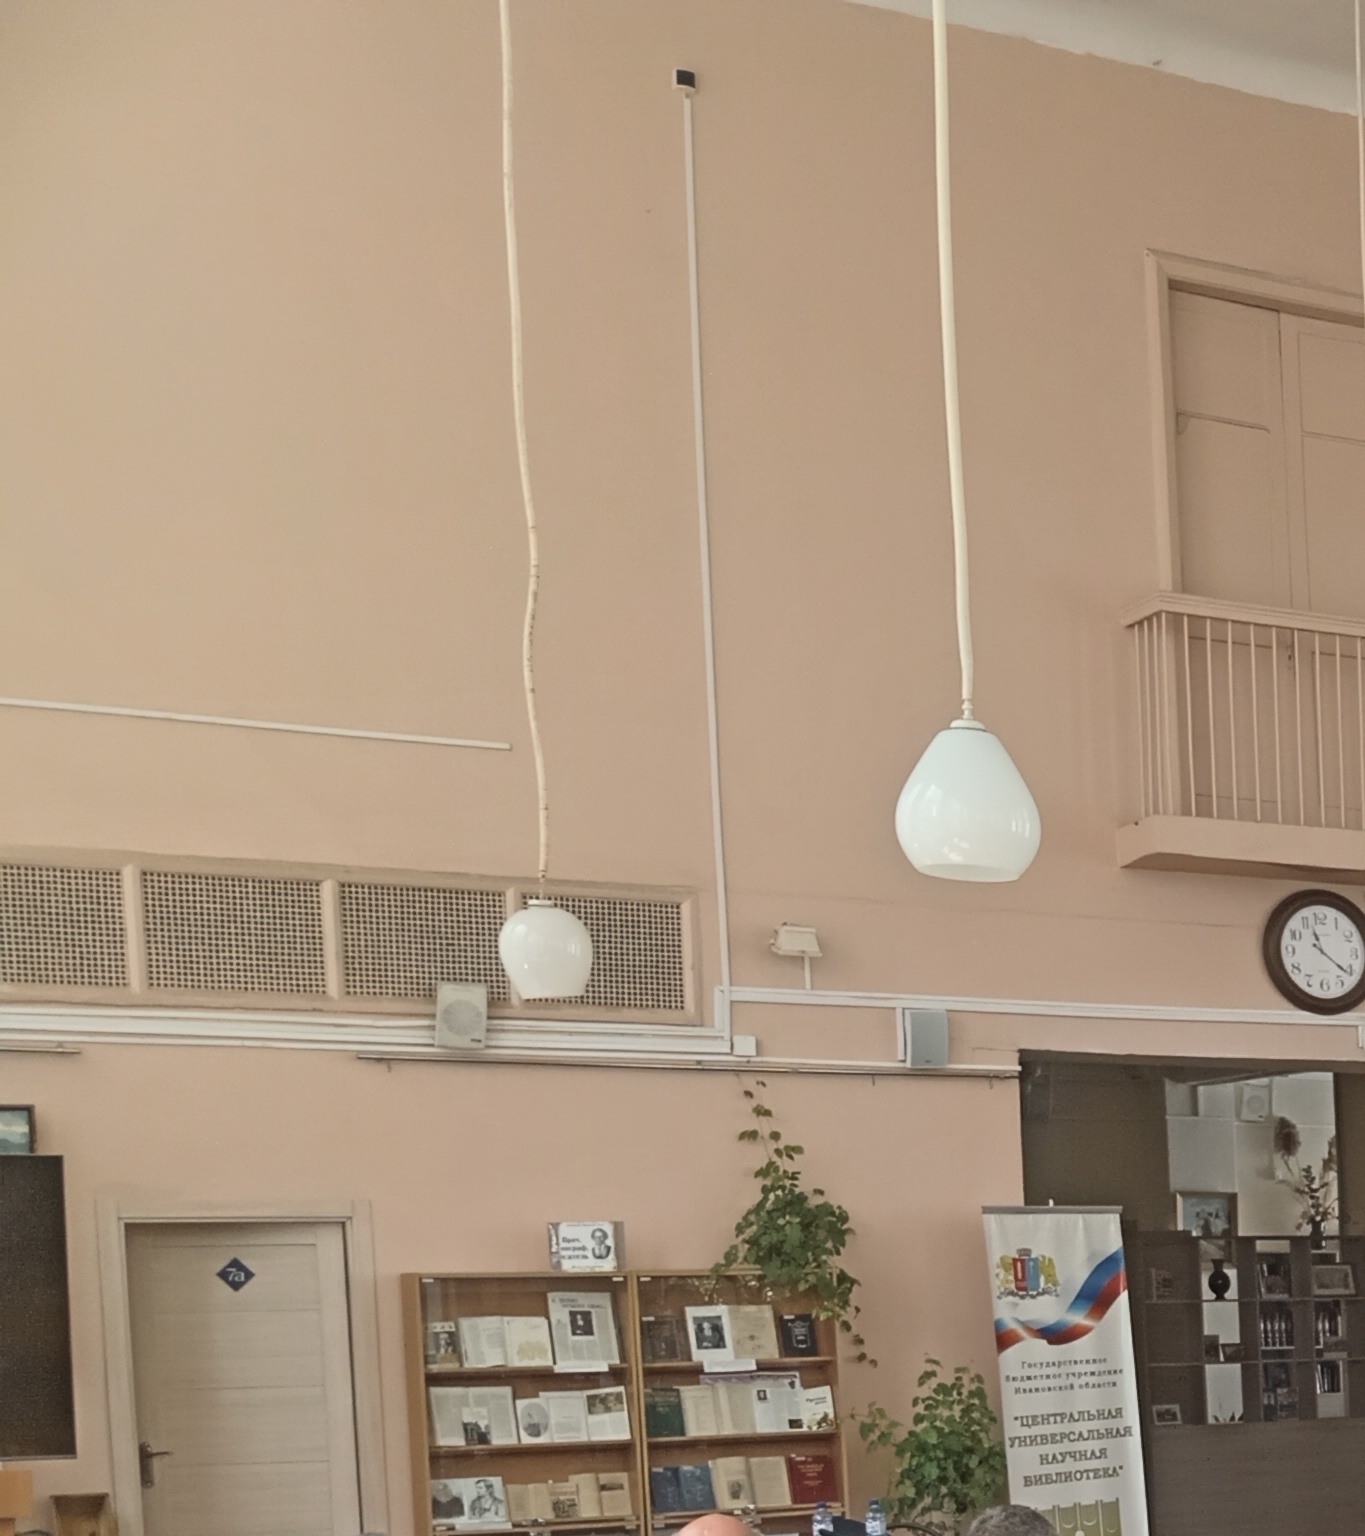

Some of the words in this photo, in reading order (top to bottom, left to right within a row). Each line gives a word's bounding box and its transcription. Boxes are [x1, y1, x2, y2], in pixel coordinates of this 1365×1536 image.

[1301, 916, 1309, 929] 11
[1313, 912, 1327, 926] 12
[1334, 917, 1338, 930] 1
[1290, 929, 1302, 941] 10
[1343, 930, 1353, 943] 2
[1285, 944, 1296, 958] 9
[1350, 947, 1359, 960] 3
[1291, 962, 1301, 975] 8
[1304, 974, 1313, 988] 7
[1320, 978, 1330, 992] 6
[1335, 975, 1345, 988] 5
[1021, 1358, 1107, 1369] Государственное
[1005, 1373, 1062, 1382] бюджетное
[1065, 1368, 1123, 1380] учреждение
[1014, 1383, 1074, 1395] Ивановской
[1078, 1381, 1117, 1390] области
[1014, 1407, 1123, 1428] "ЦЕНТРАЛЬНАЯ
[1008, 1426, 1133, 1448] УНИВЕРСАЛЬНАЯ
[1039, 1448, 1108, 1465] НАУЧНАЯ
[1023, 1465, 1123, 1487] БИБЛИОТЕКА"
